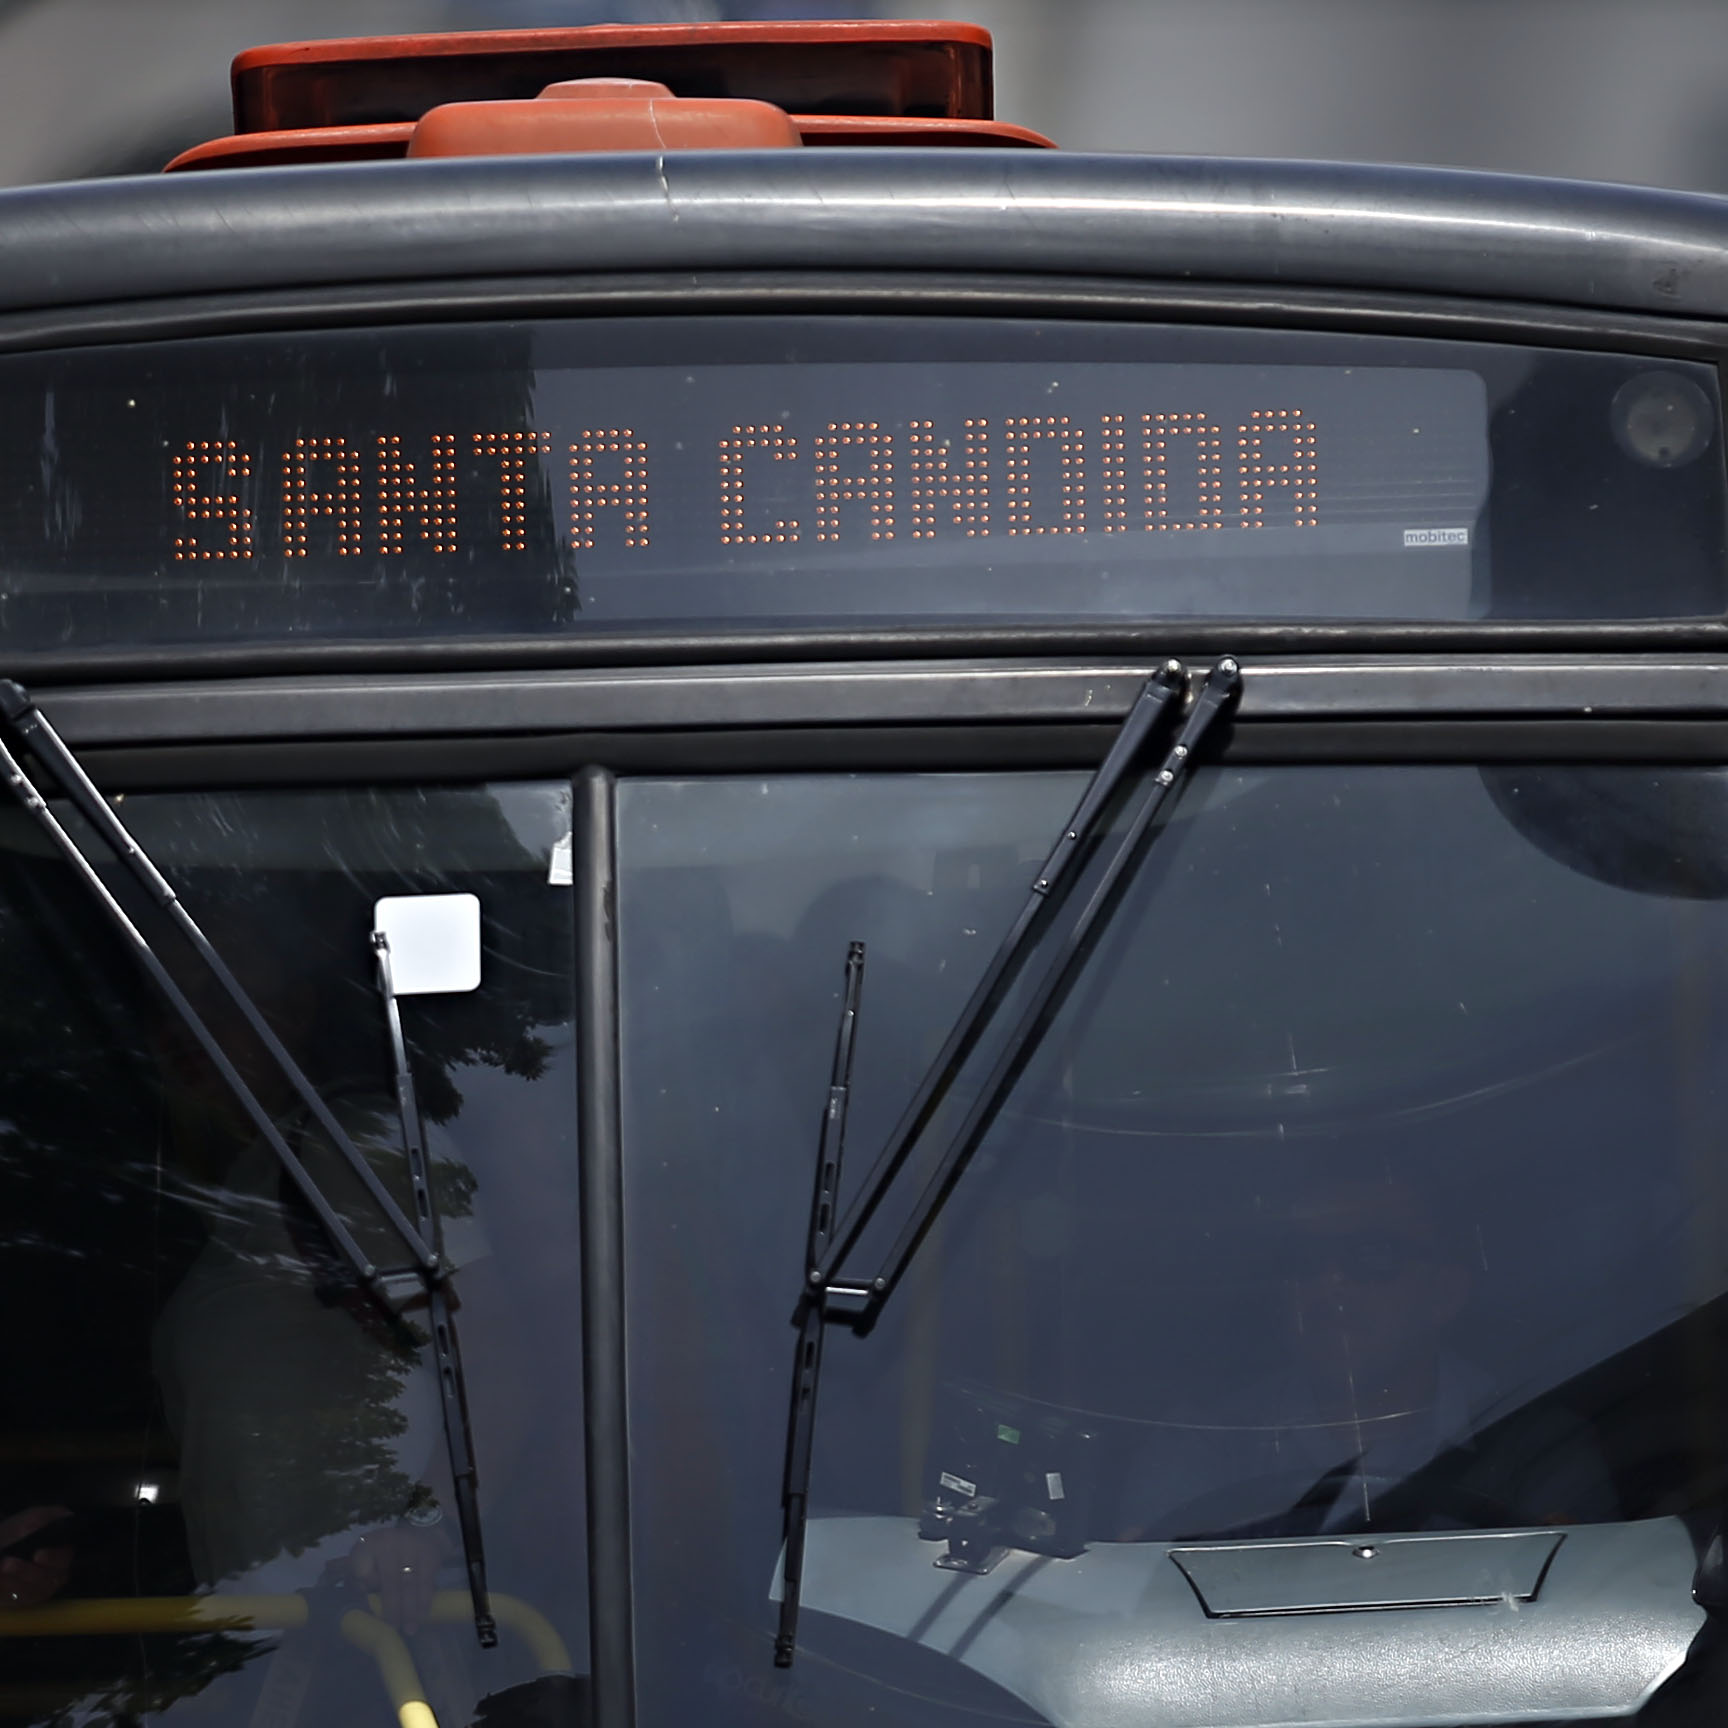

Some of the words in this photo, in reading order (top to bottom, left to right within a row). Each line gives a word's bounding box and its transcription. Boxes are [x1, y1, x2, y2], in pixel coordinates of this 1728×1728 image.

[172, 428, 649, 560] SANTA
[718, 408, 1317, 542] CANDIDA
[1406, 531, 1465, 543] mobitec
